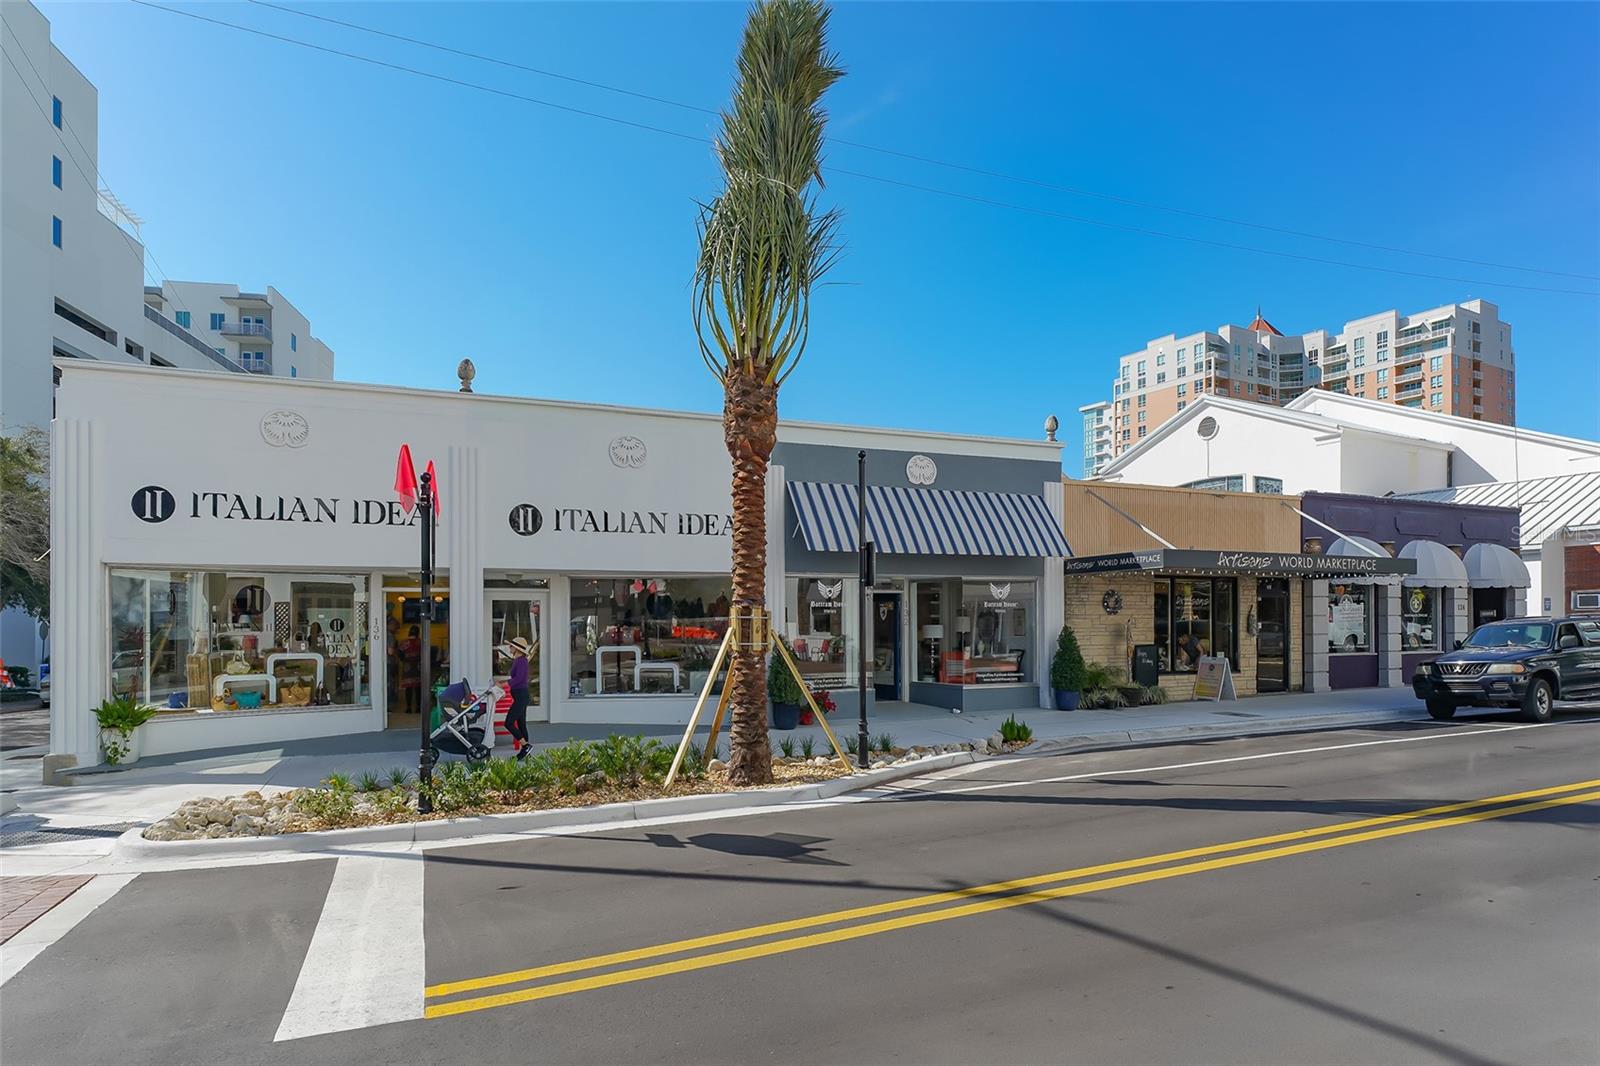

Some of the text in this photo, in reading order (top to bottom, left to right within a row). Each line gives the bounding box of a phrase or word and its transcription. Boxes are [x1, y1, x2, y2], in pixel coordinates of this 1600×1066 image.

[190, 492, 340, 523] ITALIAN
[352, 500, 422, 526] IDEA
[553, 508, 668, 534] ITALIAN
[677, 513, 734, 536] IDEA
[1098, 559, 1118, 567] WORLD
[1120, 554, 1161, 565] MARKETPLACE
[1279, 556, 1313, 568] WORLD
[1317, 558, 1377, 570] MARKETPLACE
[372, 618, 380, 640] 136
